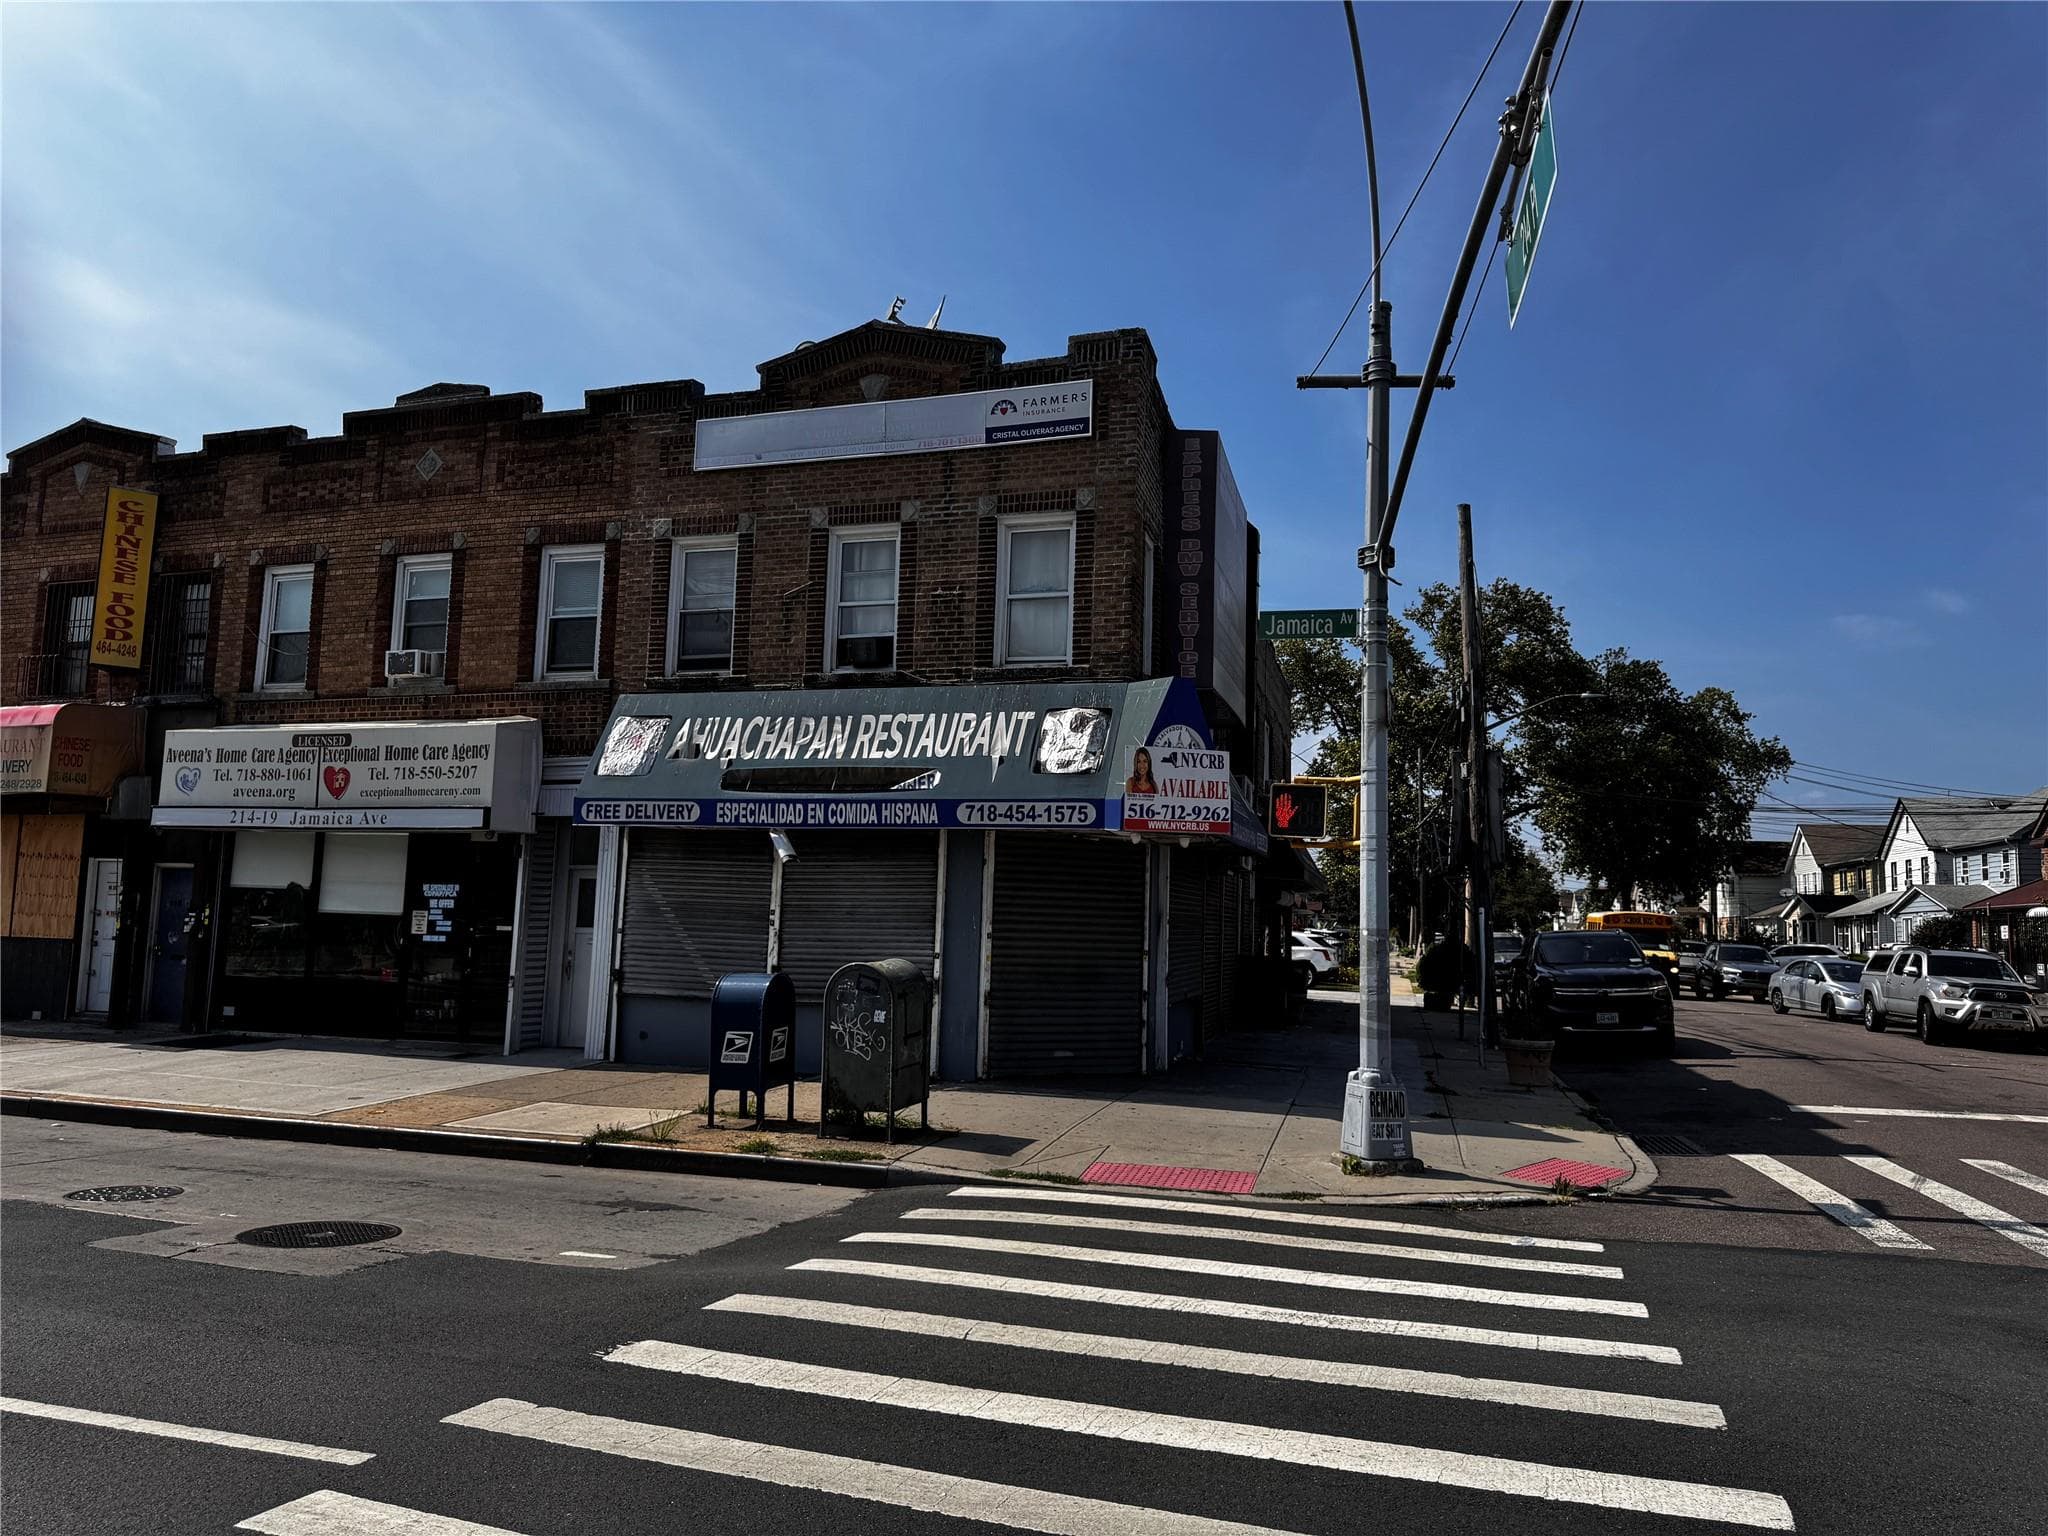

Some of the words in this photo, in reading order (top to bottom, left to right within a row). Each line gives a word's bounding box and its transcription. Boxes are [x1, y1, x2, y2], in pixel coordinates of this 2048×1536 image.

[1022, 392, 1088, 410] FARMERS
[1022, 407, 1066, 417] INSURANCE
[992, 430, 1020, 441] CRISTAL
[1020, 426, 1055, 438] OLIVERAS
[1054, 423, 1085, 435] AGENCY
[1181, 437, 1202, 532] EXPRESS
[111, 500, 145, 587] CHINESE
[1177, 538, 1204, 577] DMV
[103, 591, 135, 642] FOOD
[1265, 614, 1333, 635] Jamaica
[1340, 611, 1353, 624] Av
[1177, 582, 1200, 679] SERVICE
[96, 640, 137, 658] 464-4248
[0, 736, 46, 753] URANT
[298, 735, 346, 747] LICENSED
[665, 714, 852, 760] AHUACHAPAN
[852, 711, 1036, 759] RESTAURANT
[57, 753, 84, 768] FOOD
[166, 747, 212, 764] Aveena's
[216, 748, 247, 764] Home
[251, 747, 276, 763] Care
[277, 746, 317, 765] Agency
[322, 745, 380, 765] Exceptional
[385, 744, 420, 762] Home
[422, 743, 449, 761] Care
[451, 743, 490, 762] Agency
[1180, 752, 1225, 770] NYCRB
[213, 768, 233, 782] Tel.
[237, 767, 312, 782] 718-880-1061
[368, 767, 389, 780] Tel.
[394, 766, 478, 780] 718-550-5207
[232, 785, 296, 801] aveena.org
[360, 785, 481, 800] exceptionalhomecareny.com
[1160, 778, 1229, 800] AVAILABLE
[230, 810, 278, 825] 214-19
[290, 811, 353, 826] Jamaica
[359, 811, 388, 825] Ave
[585, 804, 623, 820] FREE
[625, 803, 695, 820] DELIVERY
[716, 802, 804, 824] ESPECIALIDAD
[807, 803, 825, 824] EN
[828, 803, 879, 824] COMIDA
[882, 802, 938, 824] HISPANA
[964, 803, 1089, 823] 718-454-1575
[1128, 803, 1230, 822] 516-712-9262
[1148, 821, 1210, 832] WWW.NYCRB.US
[1369, 1090, 1405, 1119] REMAND
